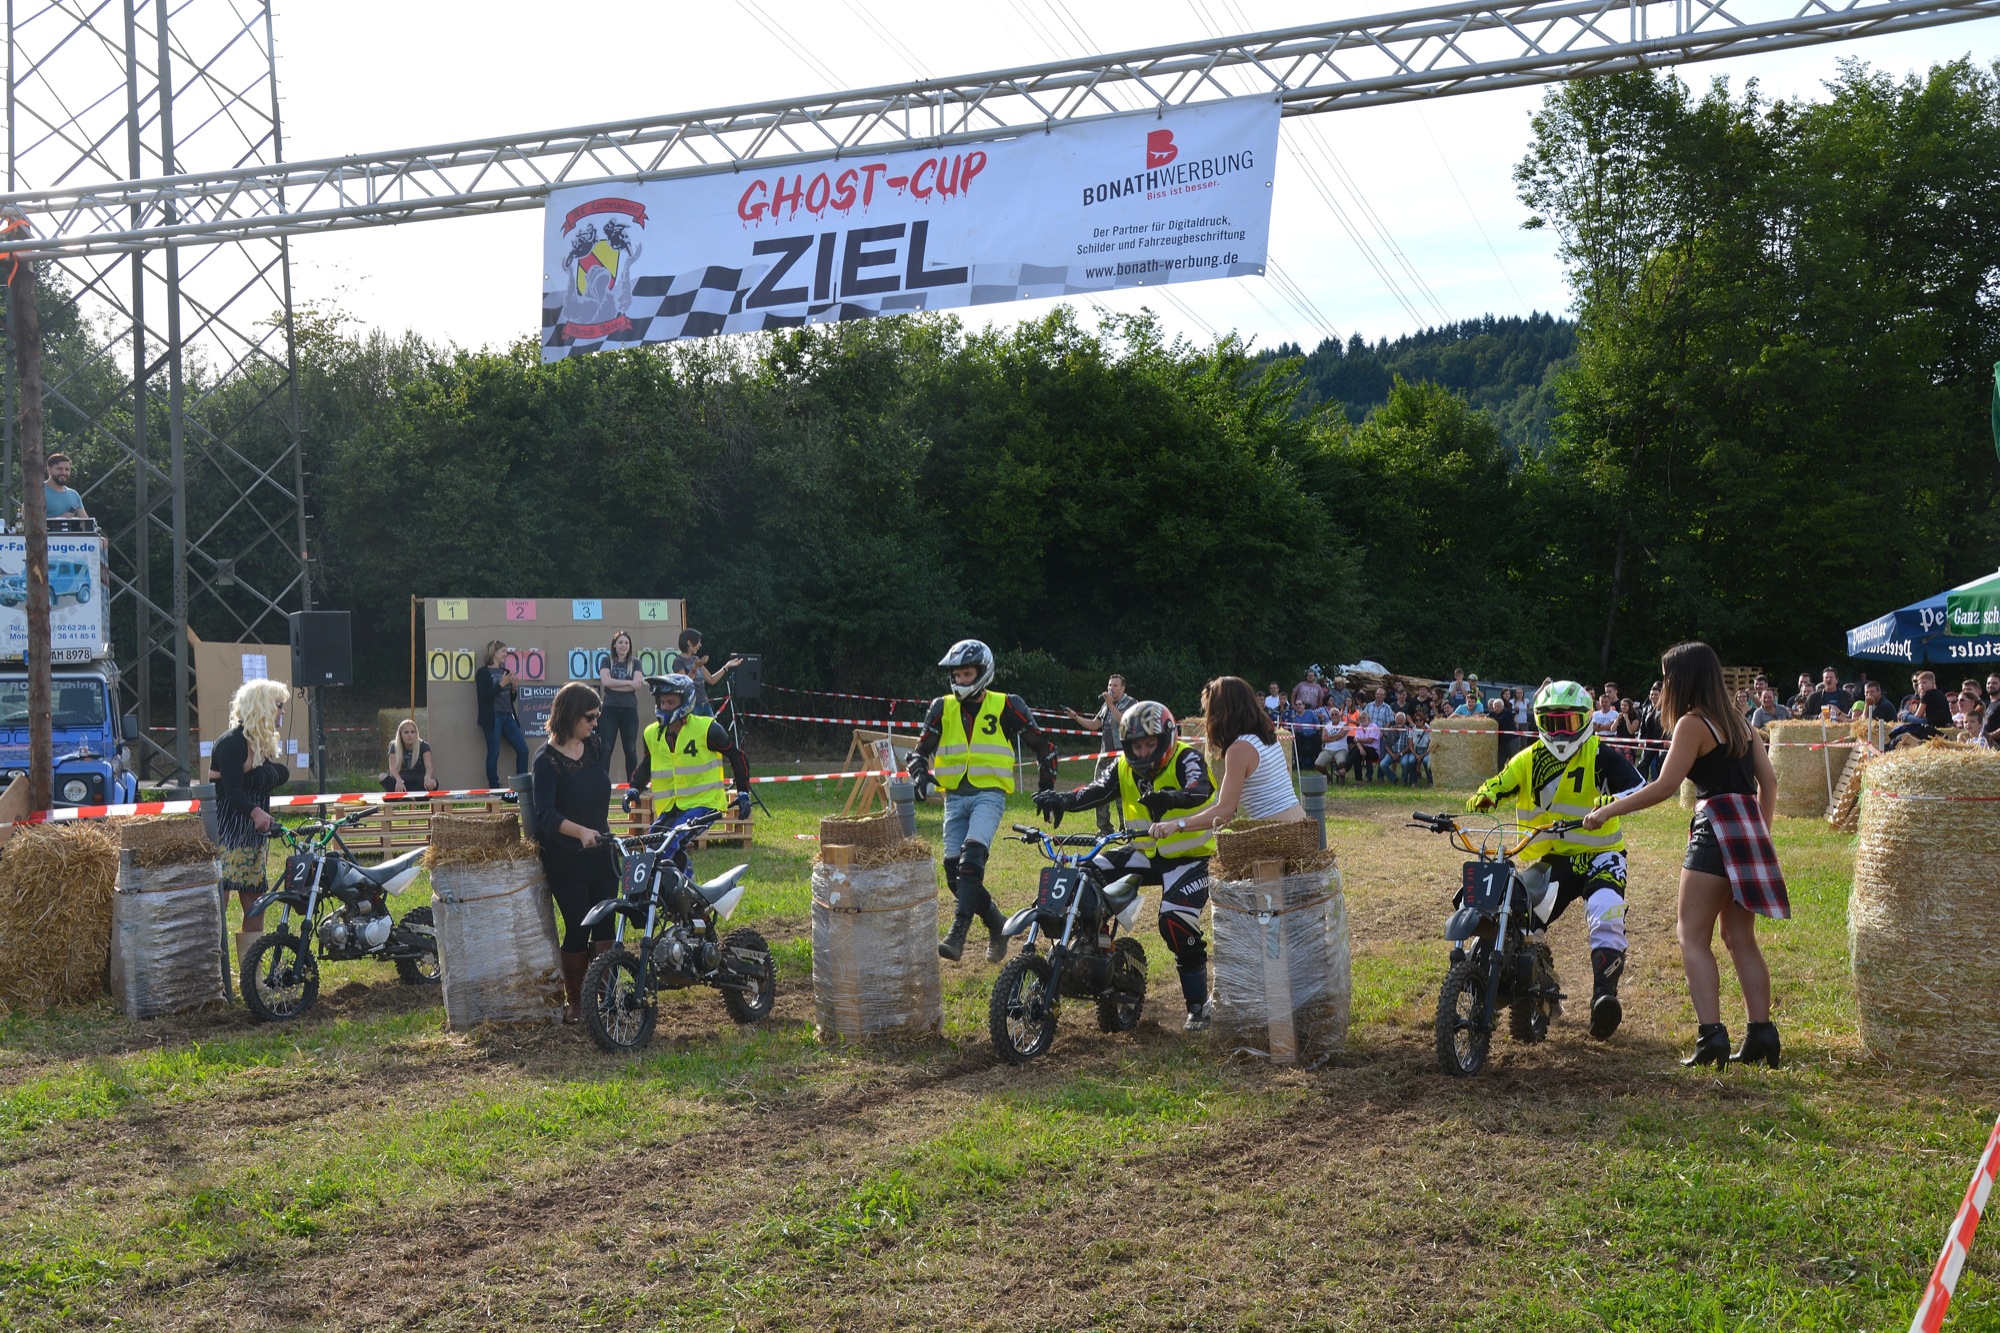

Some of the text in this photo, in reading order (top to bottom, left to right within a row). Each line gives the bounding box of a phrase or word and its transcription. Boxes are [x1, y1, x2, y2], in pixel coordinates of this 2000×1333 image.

[1083, 150, 1253, 206] BONATHWERBUNG
[737, 151, 987, 229] GHOST-CUP
[1147, 179, 1220, 200] Biss ist besser.
[1093, 215, 1231, 238] Der Partner für Digitaldruck,
[1077, 229, 1246, 255] Schilder und Fahrzeugbeschriftung
[746, 219, 968, 310] ZIEL
[1085, 251, 1239, 279] www.bonath-werbung.de
[449, 606, 455, 619] 1
[516, 606, 525, 619] 2
[582, 606, 591, 619] 3
[648, 607, 657, 619] 4
[1919, 608, 1947, 632] Pe
[1954, 607, 1980, 625] Ganz
[66, 649, 91, 660] 8978
[981, 713, 998, 735] 3
[683, 739, 698, 757] 4
[1566, 766, 1585, 793] 1
[294, 862, 306, 881] 2
[634, 862, 646, 883] 6
[1051, 878, 1067, 899] 5
[1482, 873, 1494, 896] 1
